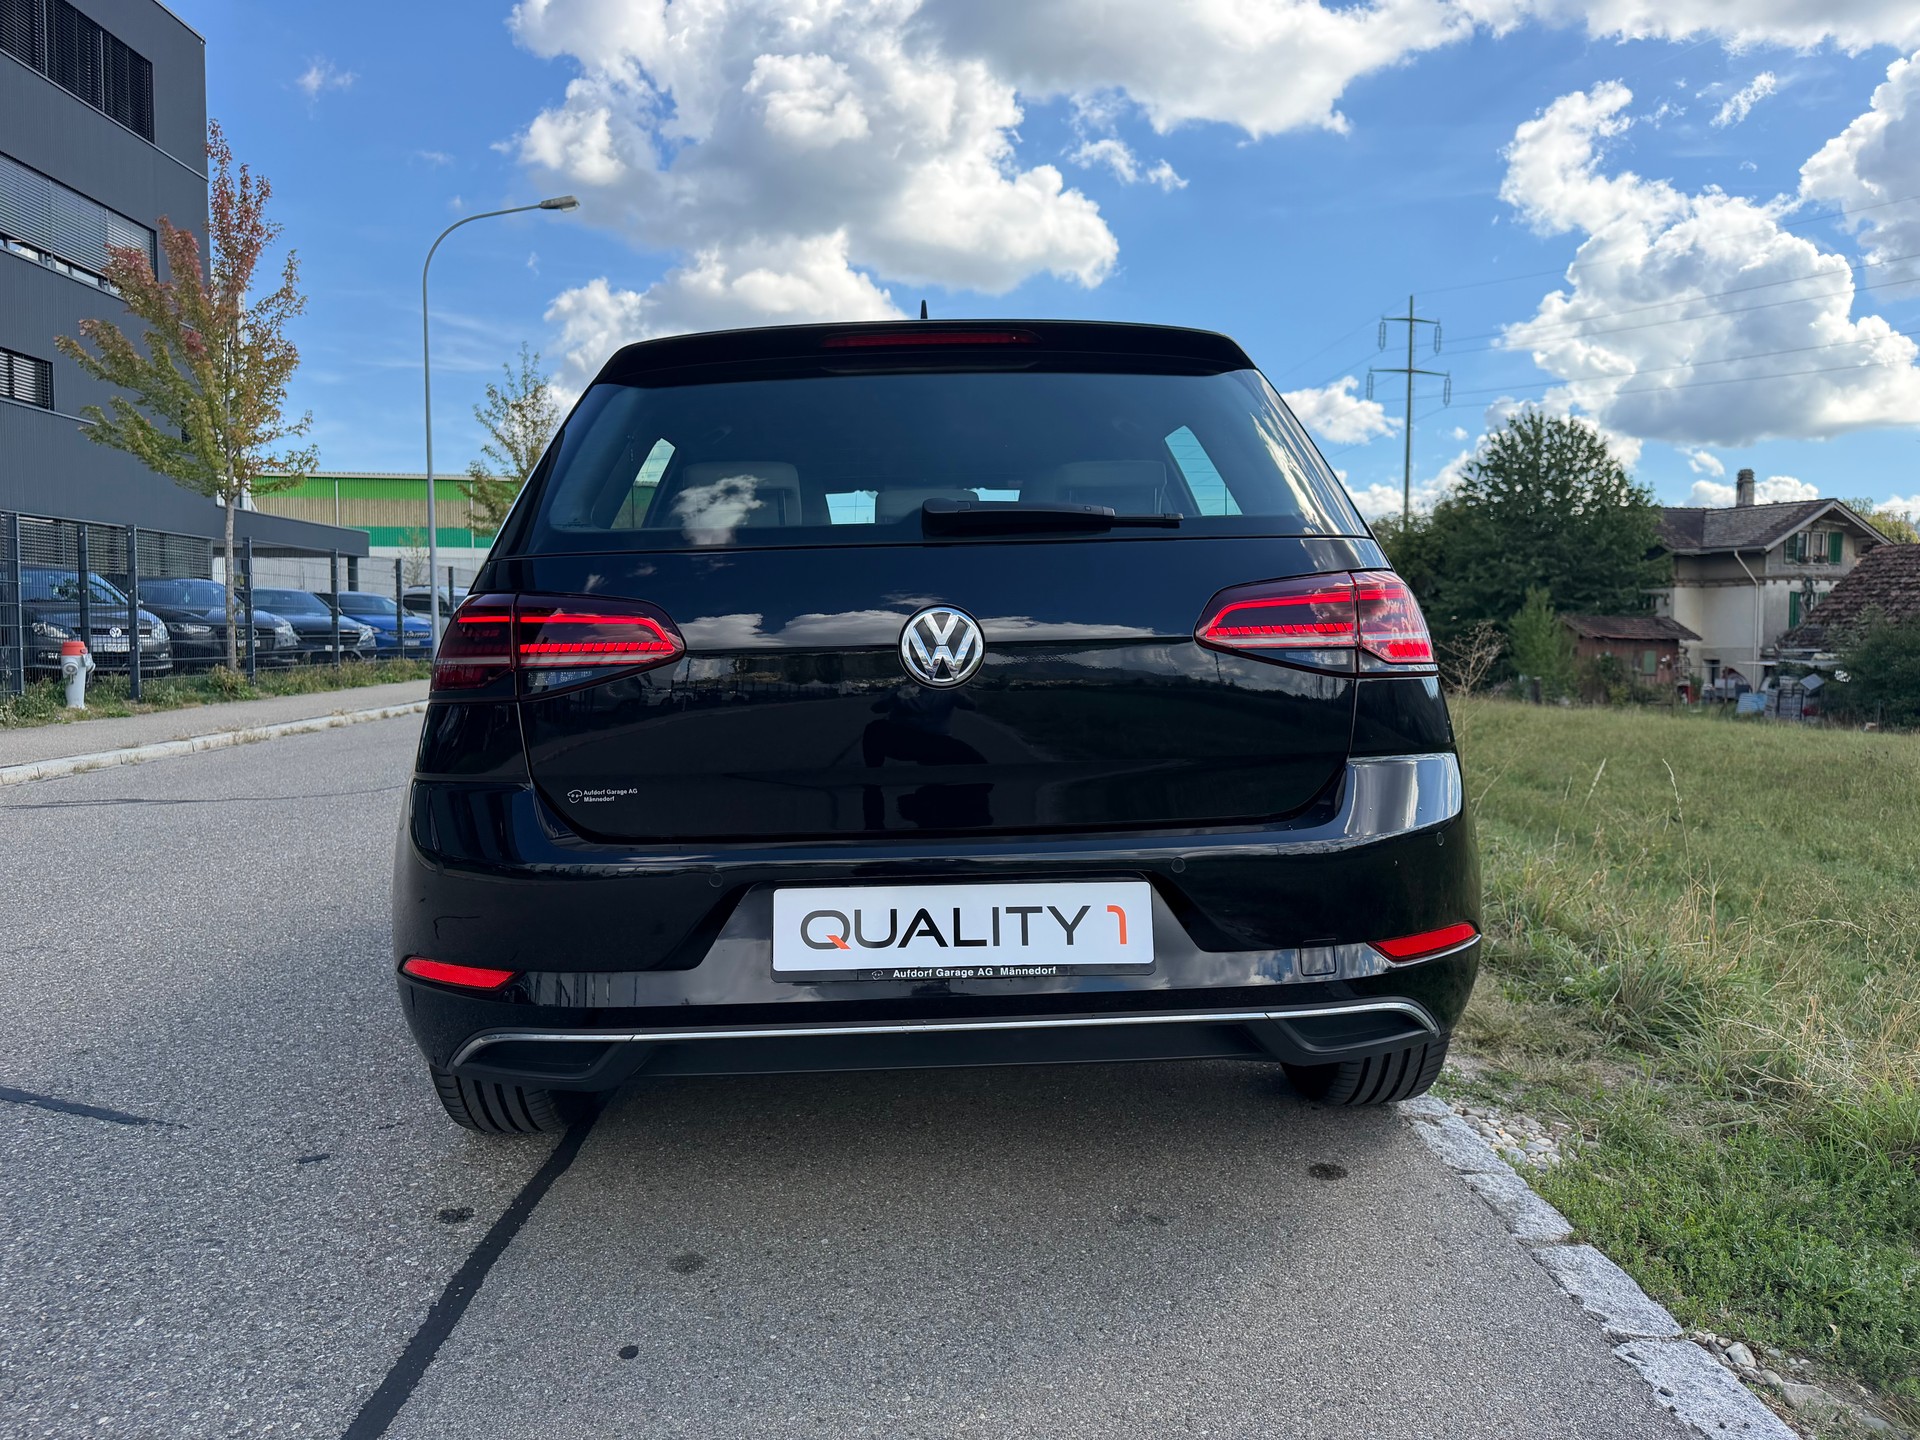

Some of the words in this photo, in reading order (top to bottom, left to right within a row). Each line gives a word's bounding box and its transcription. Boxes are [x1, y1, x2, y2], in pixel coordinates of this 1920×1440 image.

[903, 609, 982, 685] VW
[800, 905, 1091, 950] QUALITY
[1106, 905, 1128, 945] 1
[892, 969, 933, 978] Aufdorf
[935, 968, 974, 978] Garage
[977, 968, 994, 977] AG
[1000, 966, 1057, 976] Männedorf
